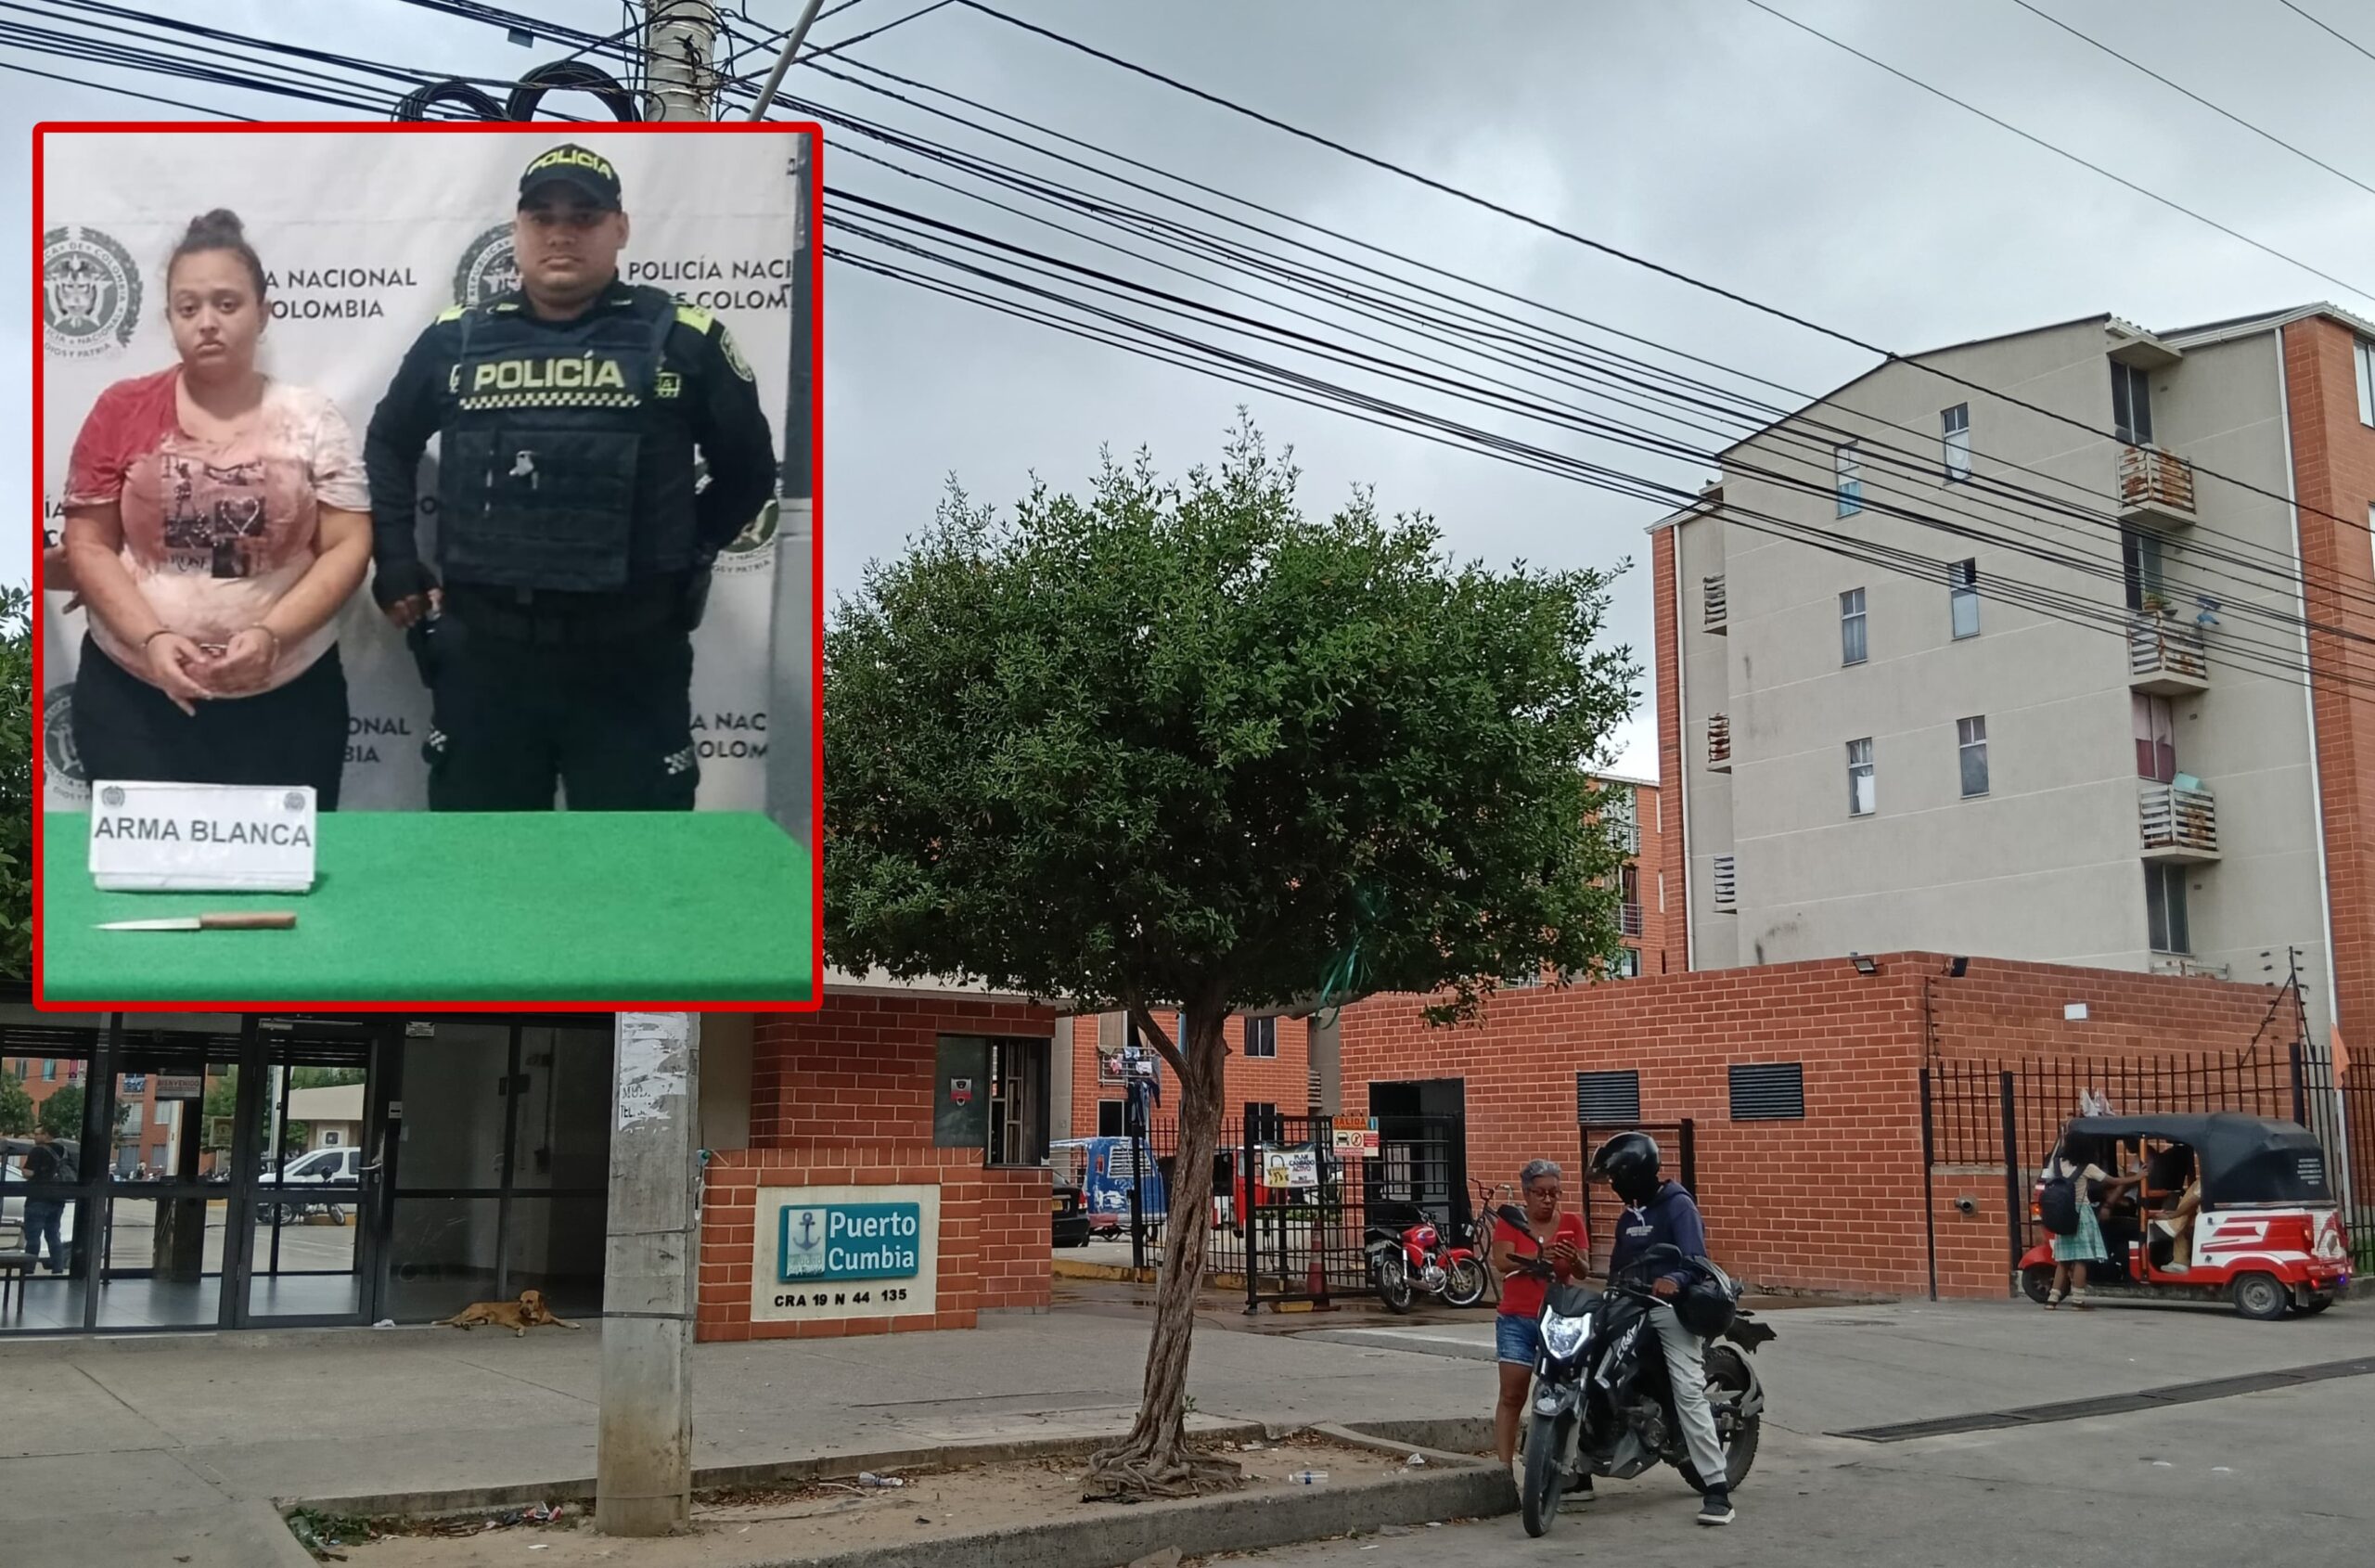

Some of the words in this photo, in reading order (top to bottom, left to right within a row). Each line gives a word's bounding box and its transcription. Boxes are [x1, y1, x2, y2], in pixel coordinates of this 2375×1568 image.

[628, 254, 723, 281] POLICÍA
[733, 259, 791, 279] NACI
[288, 268, 417, 289] NACIONAL
[271, 299, 385, 319] OLOMBIA
[697, 290, 789, 310] COLOM
[474, 350, 625, 392] POLICÍA
[349, 716, 412, 736] ONAL
[697, 739, 769, 759] OLOM
[94, 816, 180, 842] ARMA
[190, 819, 312, 848] BLANCA
[1333, 1117, 1367, 1126] SALIDA
[829, 1211, 917, 1239] Puerto
[828, 1244, 915, 1271] Cumbia
[774, 1294, 807, 1307] CRA
[812, 1293, 828, 1306] 19
[835, 1293, 845, 1305] N
[853, 1292, 870, 1304] 44
[880, 1289, 907, 1301] 135
